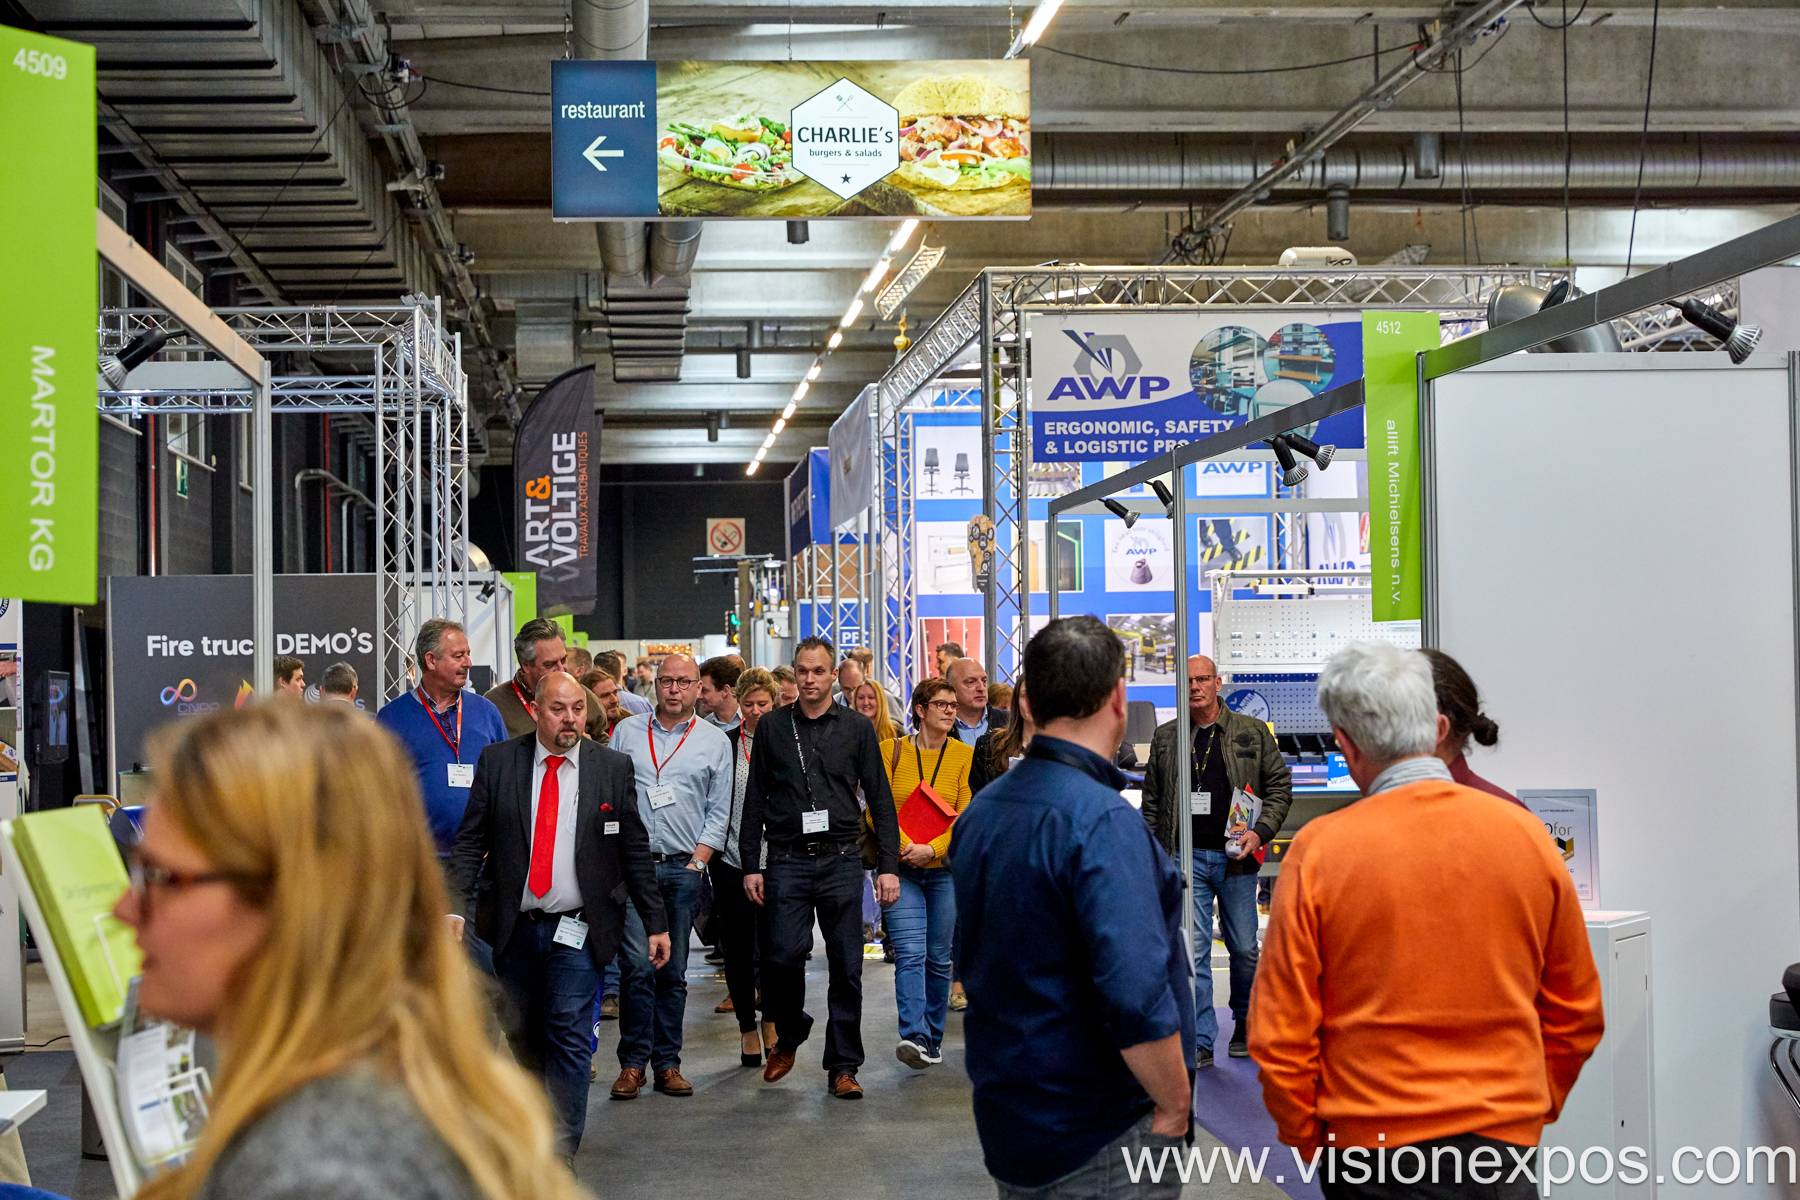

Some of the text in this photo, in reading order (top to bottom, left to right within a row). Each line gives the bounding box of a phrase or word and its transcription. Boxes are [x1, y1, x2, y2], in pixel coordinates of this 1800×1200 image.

[13, 48, 67, 80] 4509
[561, 101, 646, 119] restaurant
[797, 126, 894, 143] CHARLIE's
[809, 148, 883, 158] burgers & salads
[1376, 321, 1401, 335] 4512
[1046, 376, 1171, 401] AWP
[1044, 419, 1234, 436] ERGONOMIC, SAFETY
[29, 344, 56, 572] MARTOR KG
[1044, 441, 1058, 454] &
[1064, 439, 1149, 454] LOGISTIC
[1202, 462, 1263, 474] AWP
[551, 431, 578, 567] VOLTIGE
[577, 431, 589, 559] TRAVAUX ACROBATIQUES
[1387, 462, 1402, 568] Michielsens
[1391, 575, 1401, 605] n.v.
[147, 627, 373, 657] Fire truc DEMO'S
